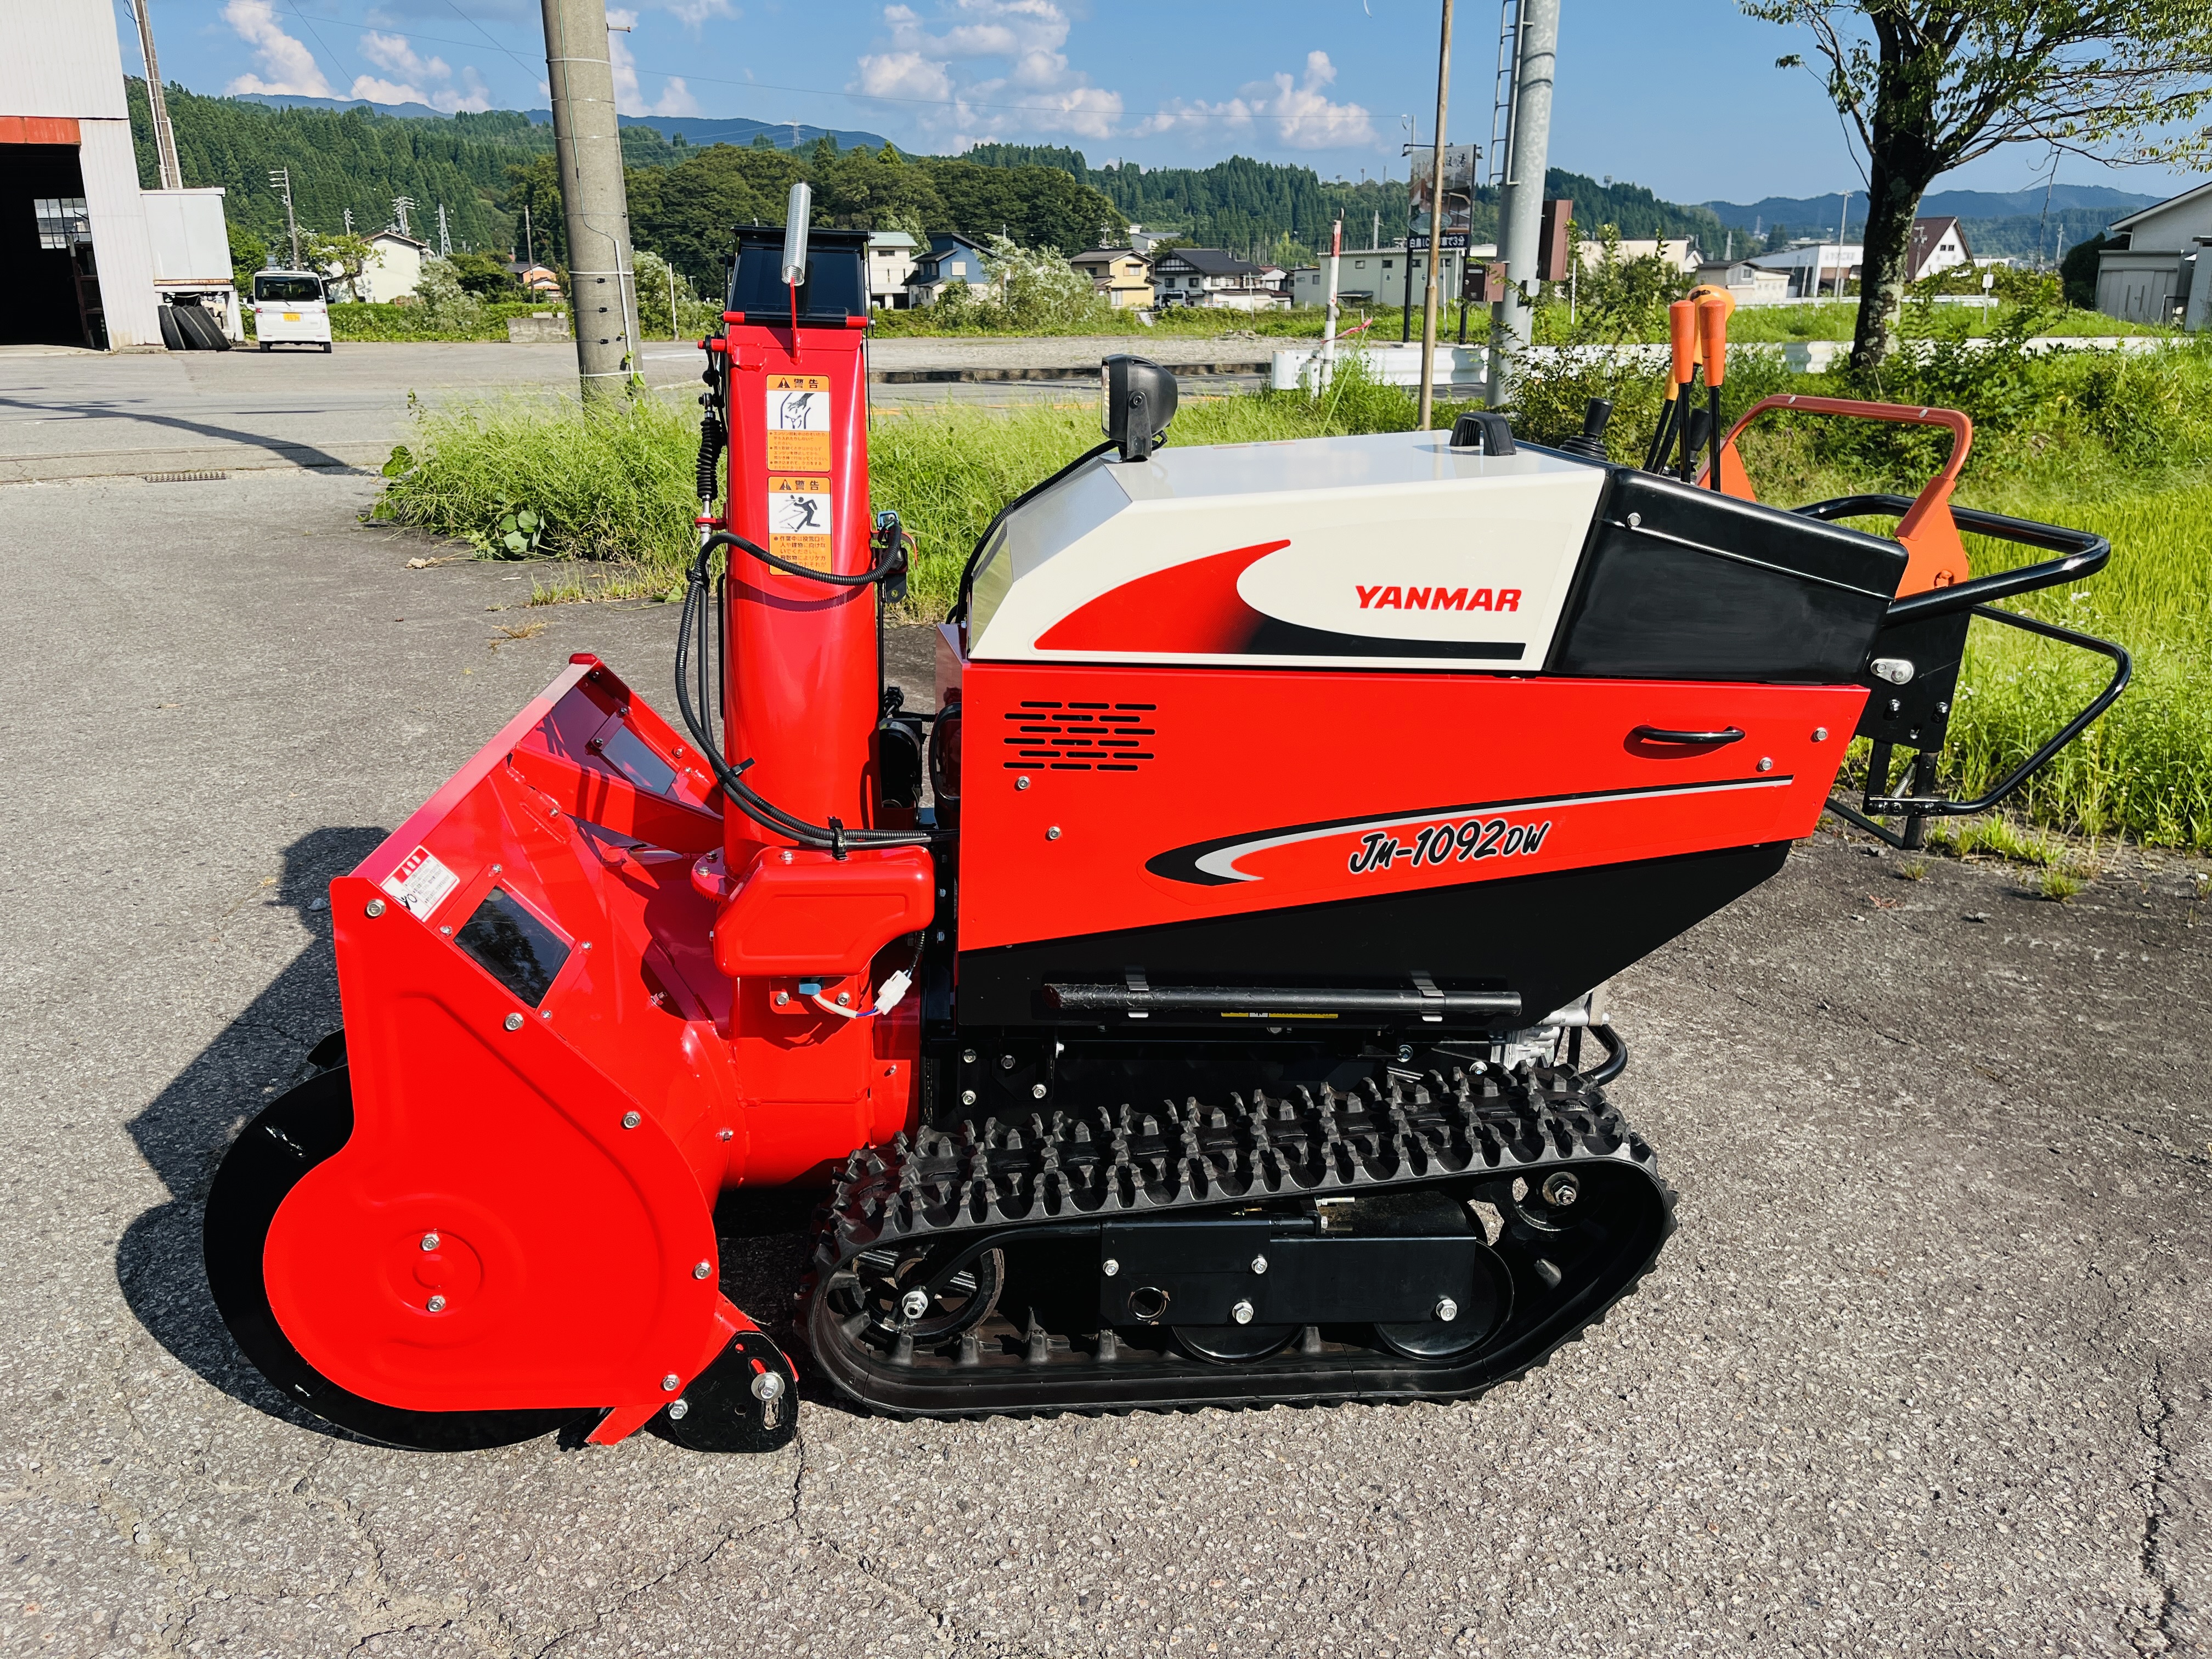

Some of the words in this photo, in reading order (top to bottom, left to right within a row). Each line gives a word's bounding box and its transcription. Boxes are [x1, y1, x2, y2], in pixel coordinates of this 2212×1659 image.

[794, 379, 819, 388] 警告
[795, 480, 819, 490] 警告
[1355, 585, 1522, 612] YANMAR
[1348, 817, 1553, 874] JM-1092DW
